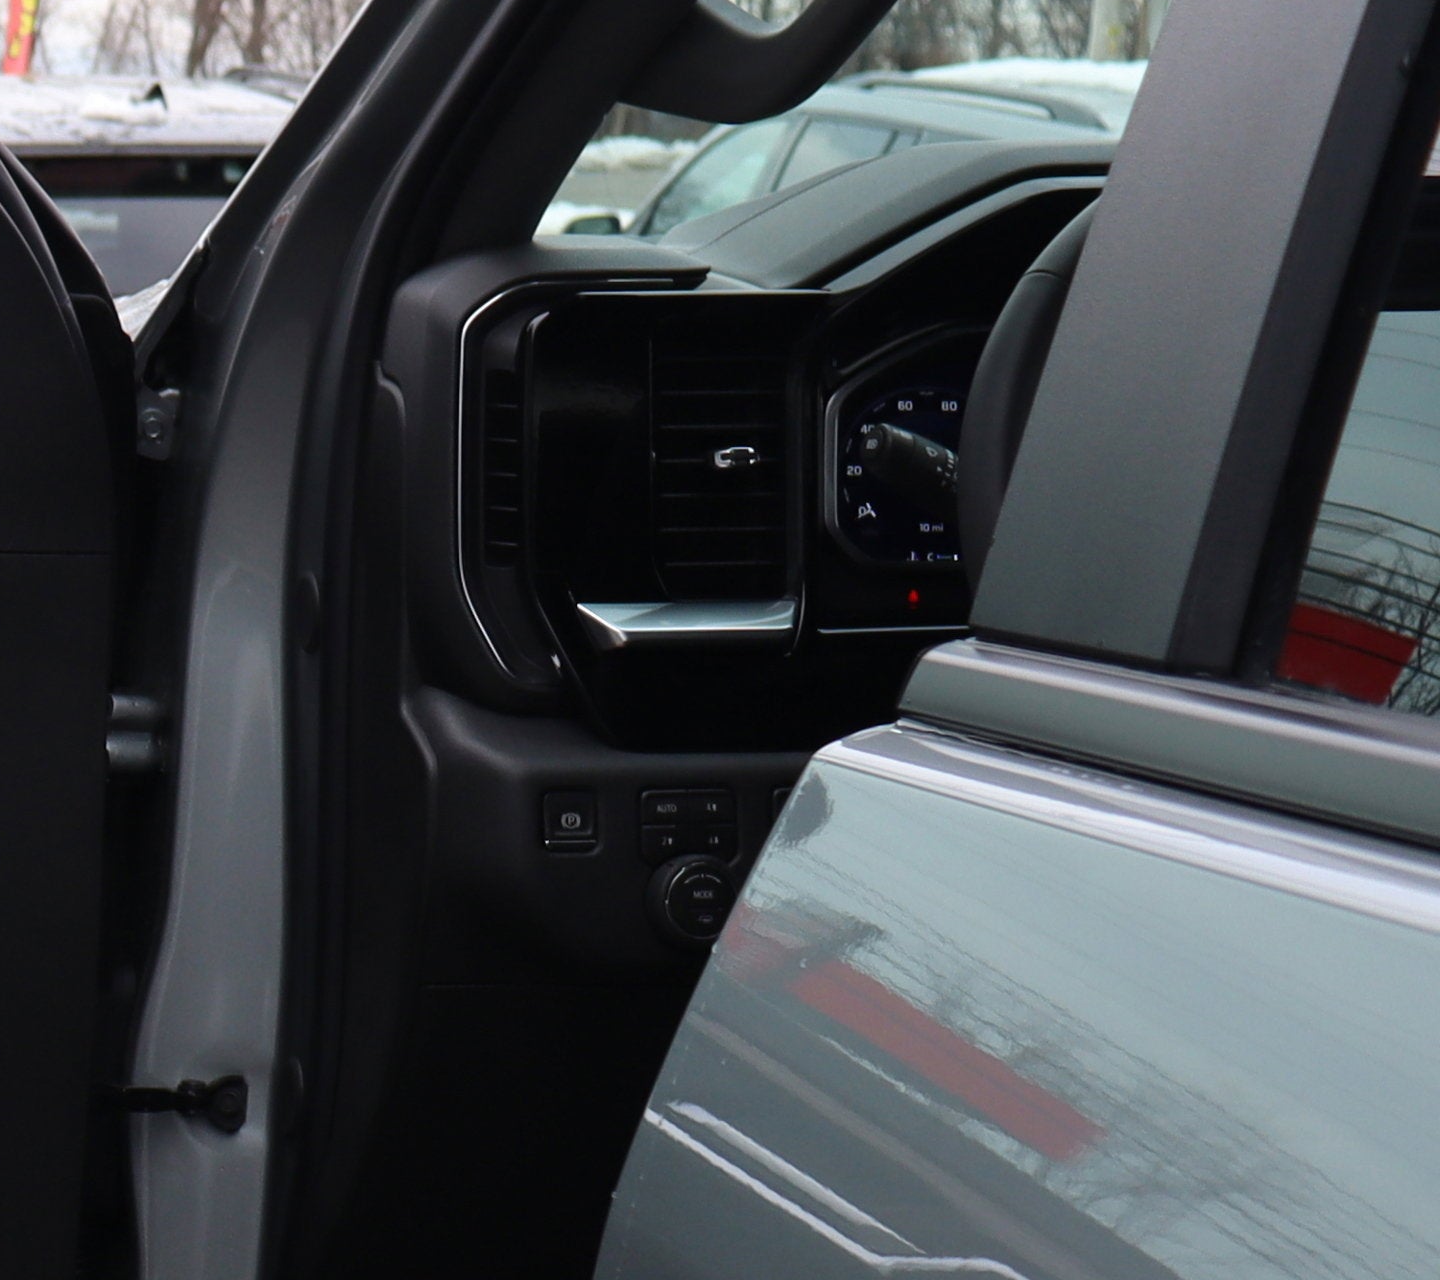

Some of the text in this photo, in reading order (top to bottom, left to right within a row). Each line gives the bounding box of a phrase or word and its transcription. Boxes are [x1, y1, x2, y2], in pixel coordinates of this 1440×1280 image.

[897, 401, 958, 412] 60 80
[846, 465, 862, 476] 20
[919, 522, 944, 532] 10 mi
[656, 803, 677, 813] AUTO
[693, 889, 714, 899] MODE
